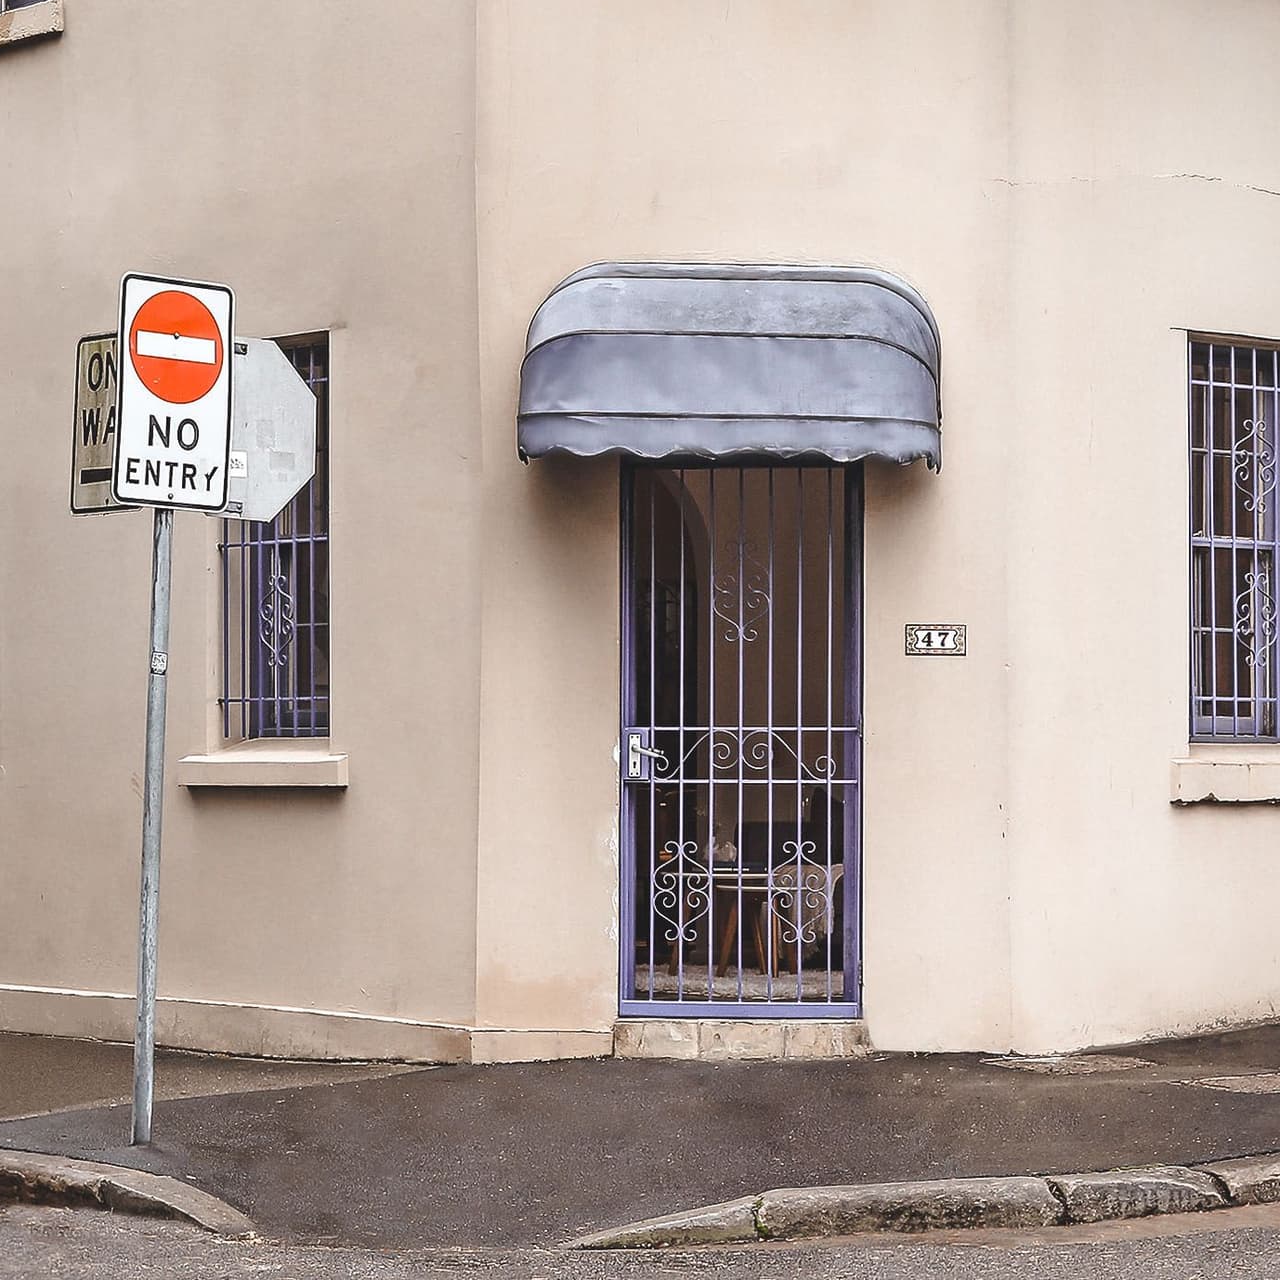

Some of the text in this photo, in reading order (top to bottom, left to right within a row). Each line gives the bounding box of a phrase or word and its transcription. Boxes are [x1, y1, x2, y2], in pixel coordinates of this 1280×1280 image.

[87, 351, 118, 391] ON
[82, 405, 116, 446] WA
[147, 414, 200, 451] NO
[125, 457, 219, 492] ENTRY
[921, 631, 950, 647] 47
